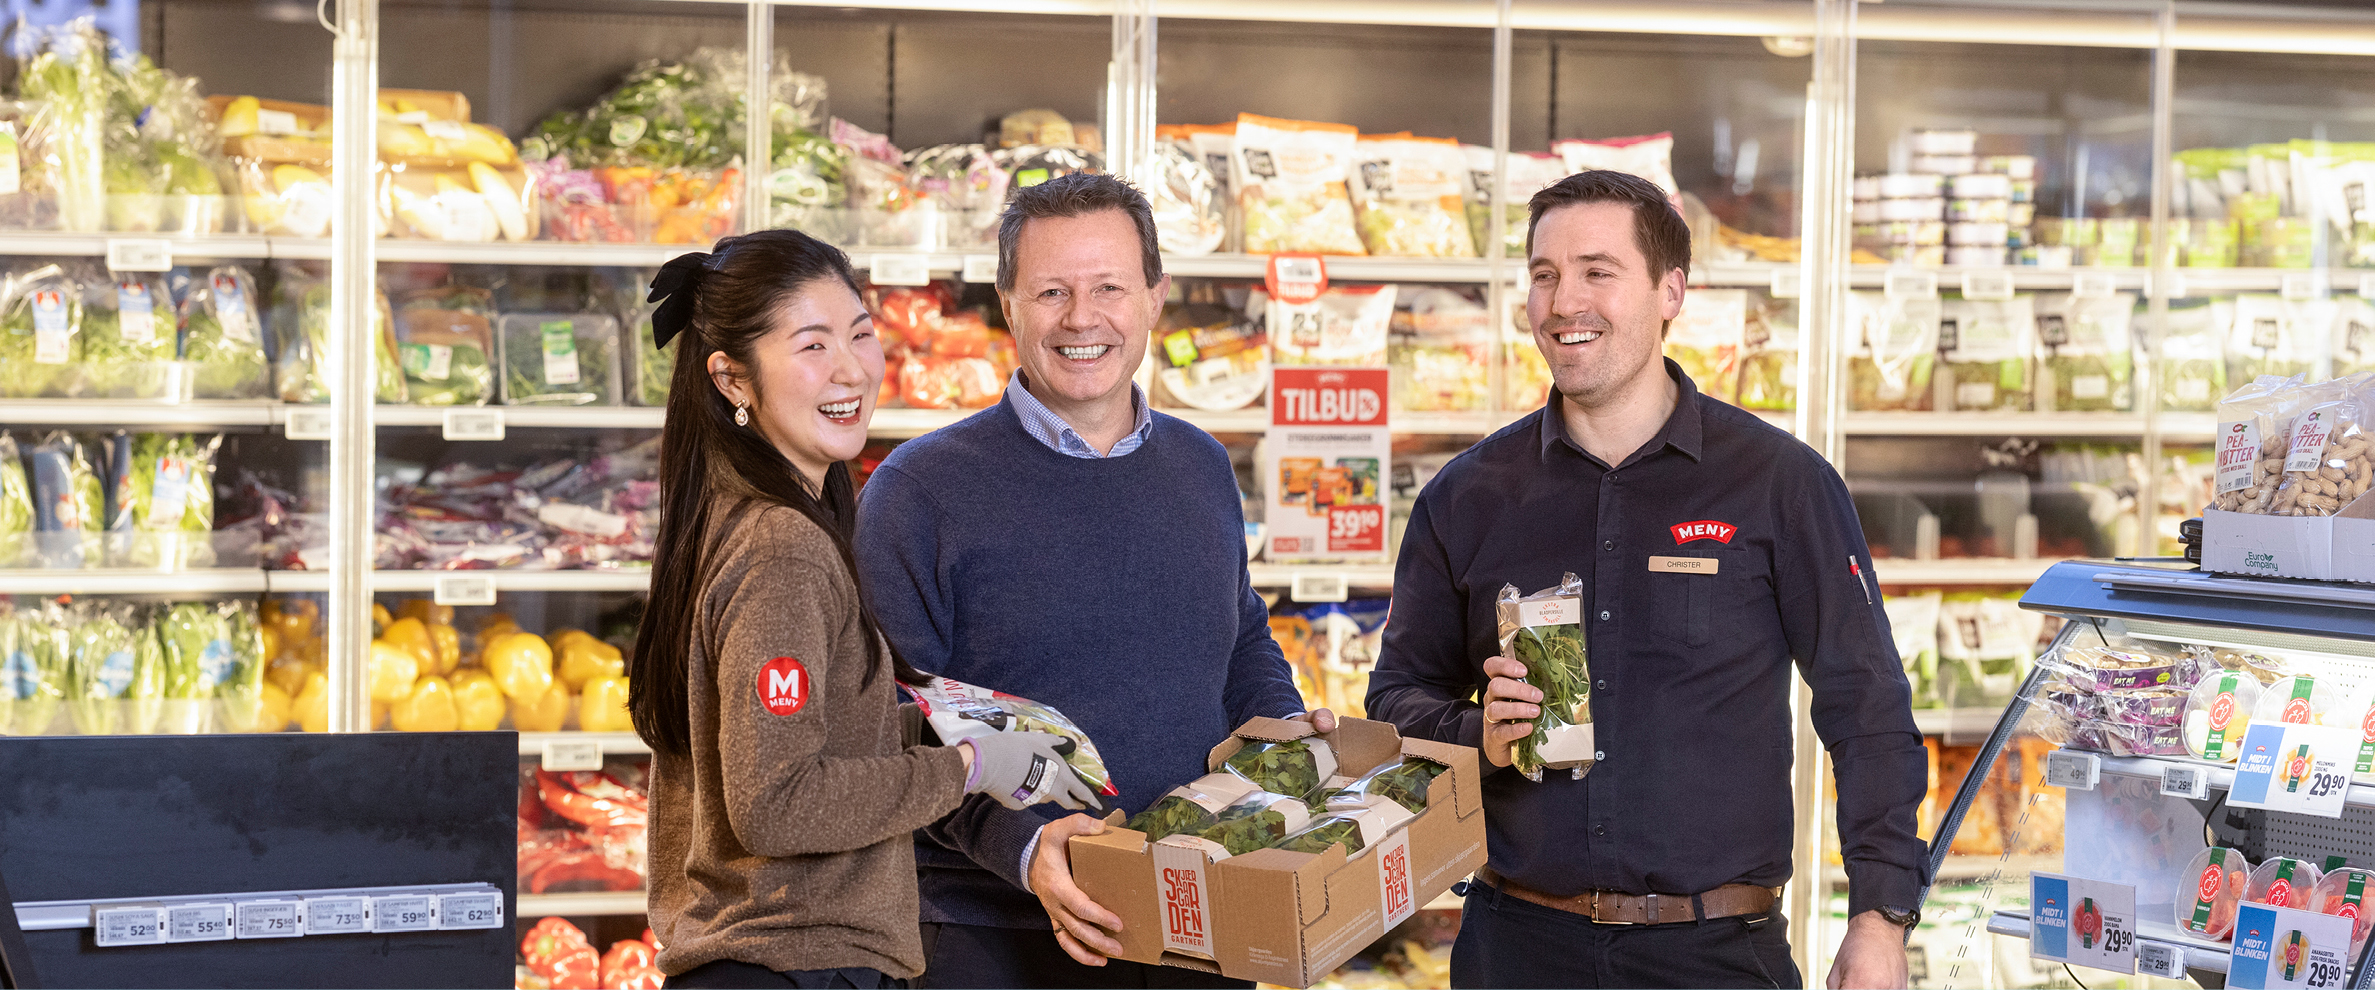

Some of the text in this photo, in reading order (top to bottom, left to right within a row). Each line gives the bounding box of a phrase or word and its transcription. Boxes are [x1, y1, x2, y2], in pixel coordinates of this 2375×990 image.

[1281, 388, 1380, 421] TILBUD
[2226, 434, 2248, 448] PEA-
[2218, 446, 2255, 467] NØTTER
[1678, 524, 1730, 539] MENY
[2248, 551, 2265, 561] Euro
[2245, 558, 2278, 572] Company
[769, 669, 799, 699] M
[2113, 677, 2126, 685] EAT
[769, 697, 799, 708] MENY
[2150, 706, 2164, 715] EAT
[2154, 736, 2167, 744] EAT
[2248, 754, 2272, 764] MIDT I
[2239, 763, 2272, 774] BLINKEN
[1388, 903, 1410, 923] GARTNERI
[2041, 907, 2063, 917] MIDT I
[2035, 916, 2066, 928] BLINKEN
[1171, 935, 1205, 947] GARTNERI
[2242, 938, 2266, 950] MIDT I
[2234, 946, 2269, 960] BLINKEN
